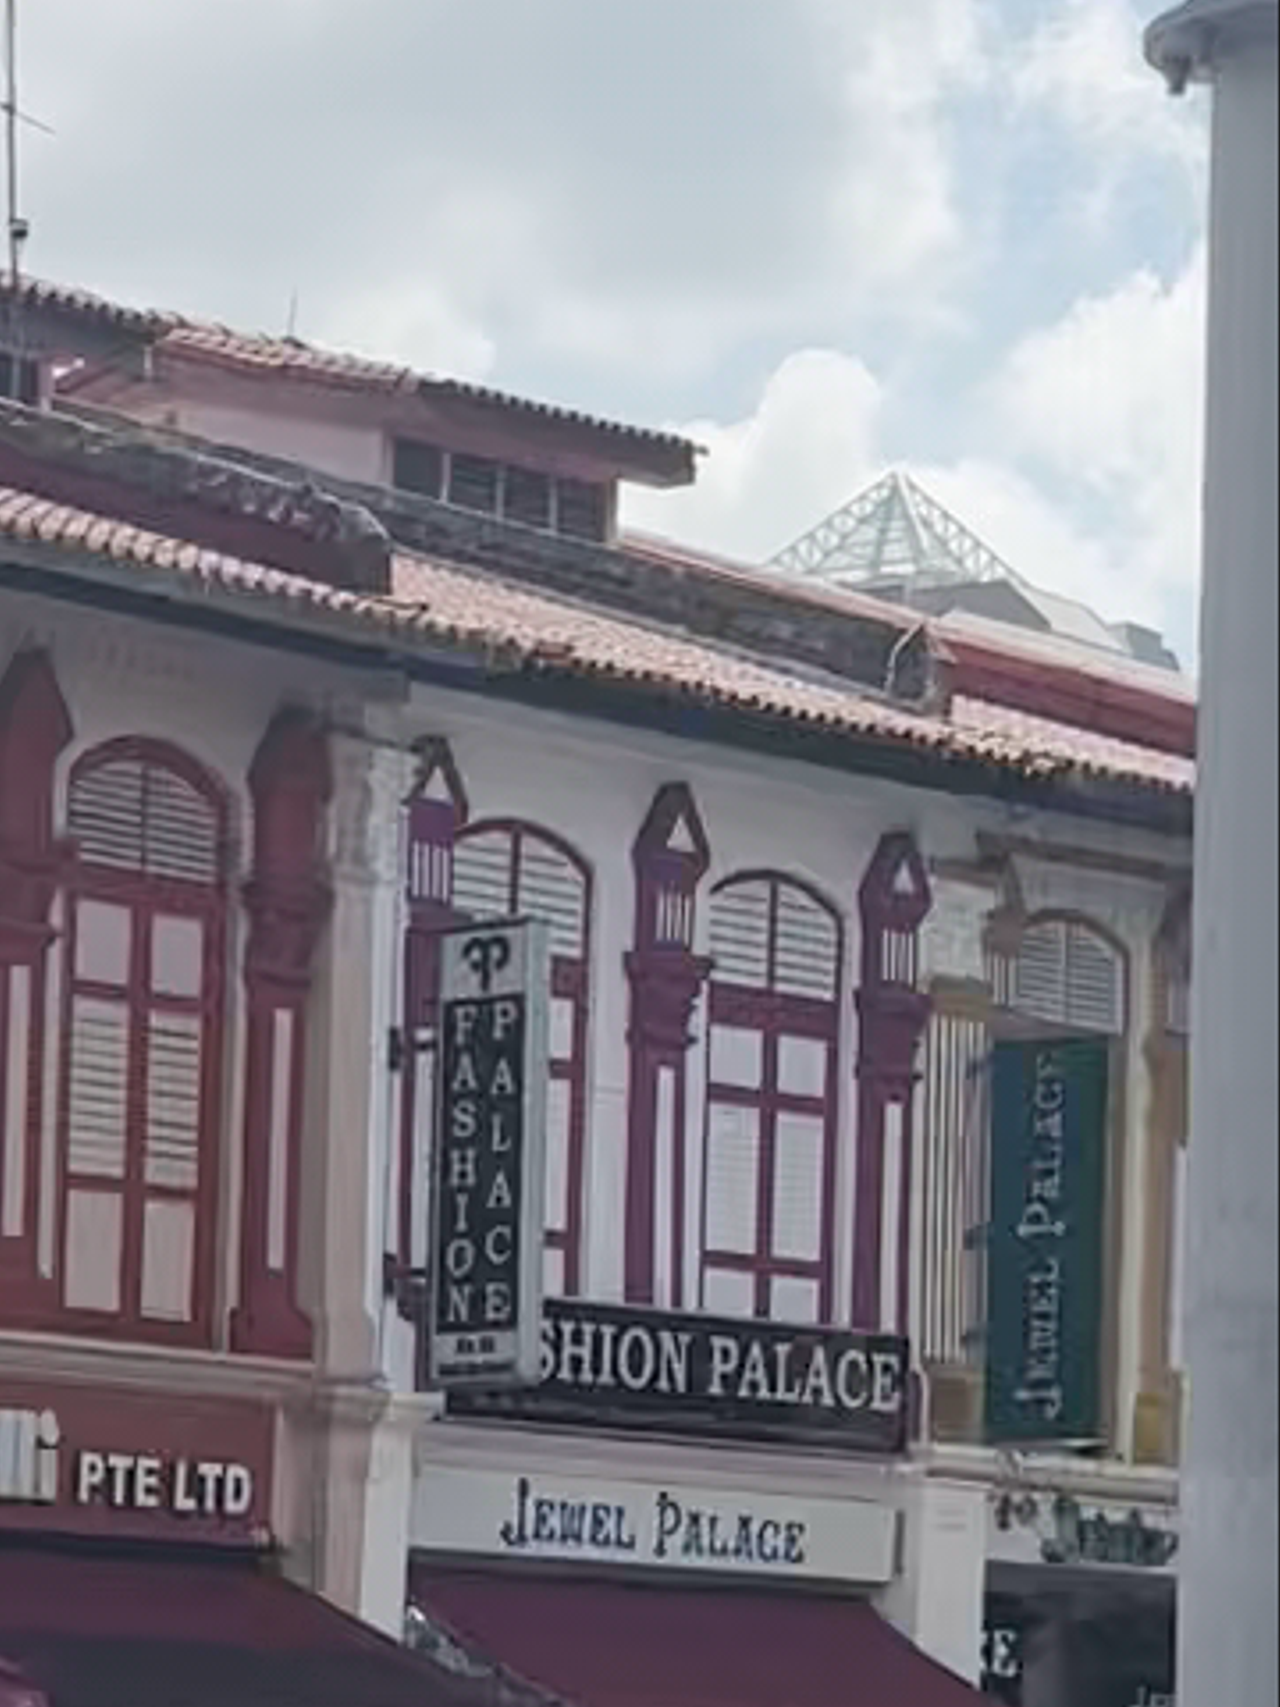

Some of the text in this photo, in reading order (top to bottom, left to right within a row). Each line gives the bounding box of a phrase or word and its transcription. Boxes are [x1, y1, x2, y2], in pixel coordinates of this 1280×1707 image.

[446, 999, 518, 1324] FASHION PALACE
[707, 1336, 901, 1413] PALACE
[77, 1450, 162, 1509] PTE
[173, 1458, 253, 1514] LTD
[499, 1476, 806, 1565] JEWEL PALACE
